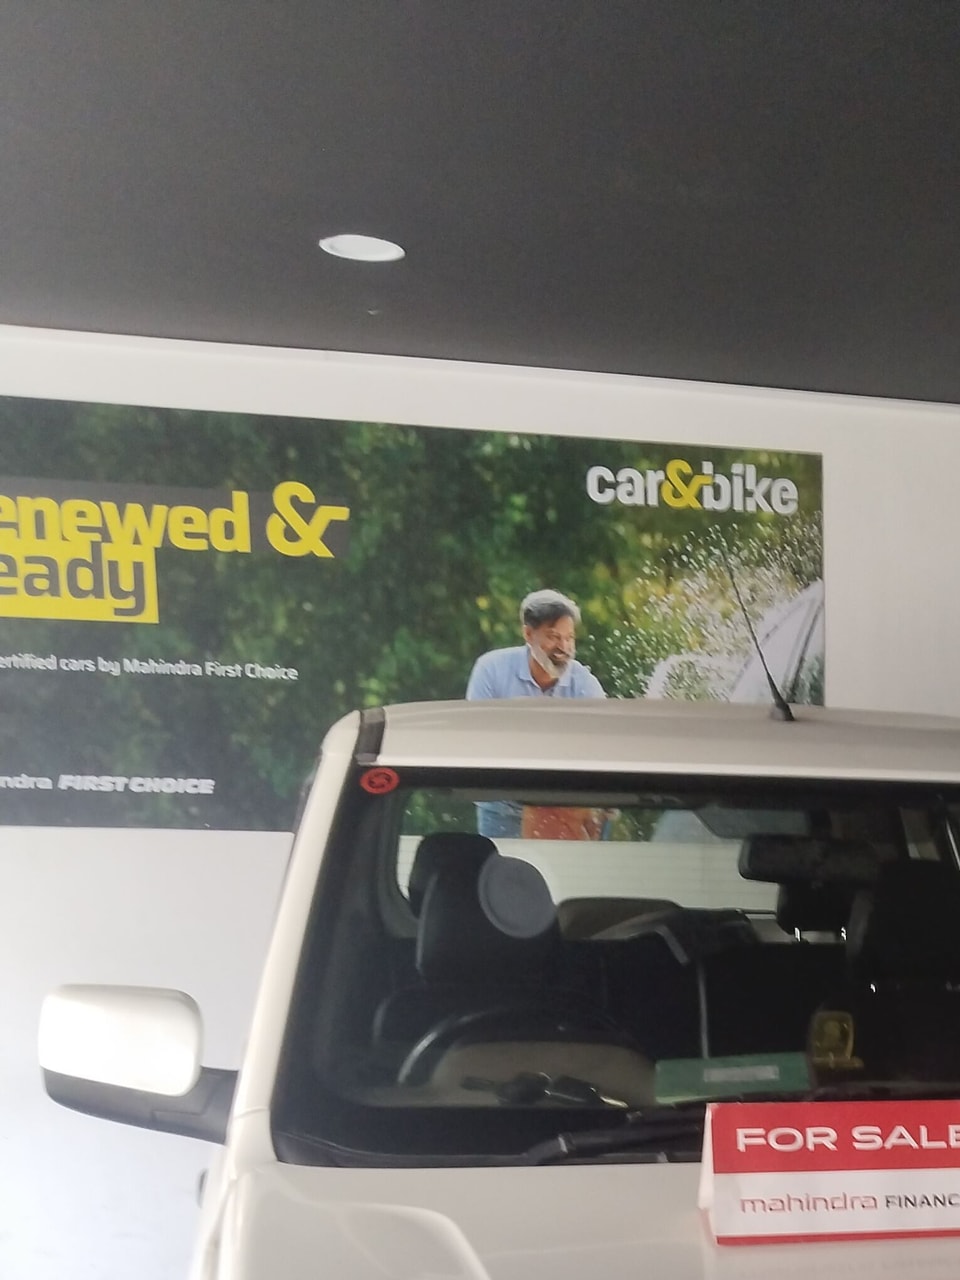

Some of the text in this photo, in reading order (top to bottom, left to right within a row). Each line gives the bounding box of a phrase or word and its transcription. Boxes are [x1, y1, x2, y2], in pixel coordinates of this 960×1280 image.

[585, 458, 799, 516] car&bike
[265, 480, 350, 558] &
[59, 658, 97, 673] cars
[97, 656, 121, 677] by
[123, 657, 202, 677] Mahindra
[205, 660, 243, 679] First
[245, 662, 299, 681] Choice
[58, 774, 129, 793] FIRST
[129, 776, 216, 795] CHOICE
[736, 1125, 839, 1153] FOR
[739, 1191, 879, 1214] mahindra
